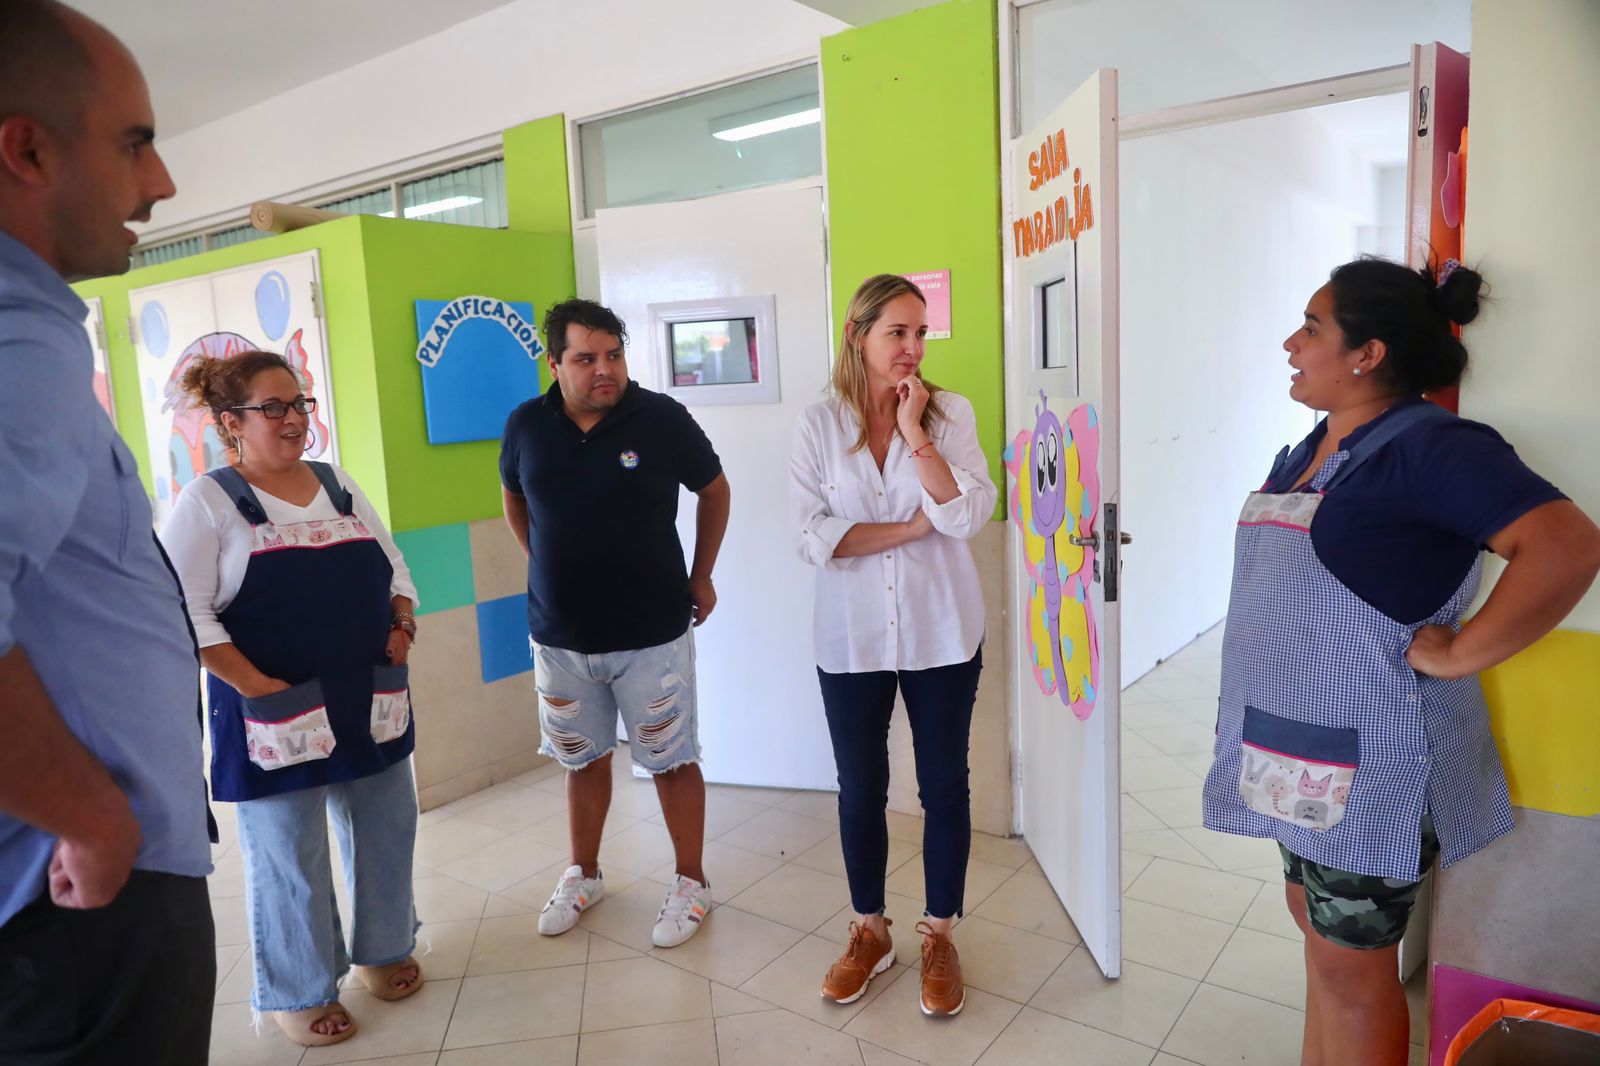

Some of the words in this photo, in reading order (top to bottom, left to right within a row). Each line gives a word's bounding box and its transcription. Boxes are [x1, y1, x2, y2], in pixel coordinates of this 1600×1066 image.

[911, 273, 943, 282] personas
[927, 281, 941, 289] sala
[418, 298, 543, 363] PLANIFICACIÓN
